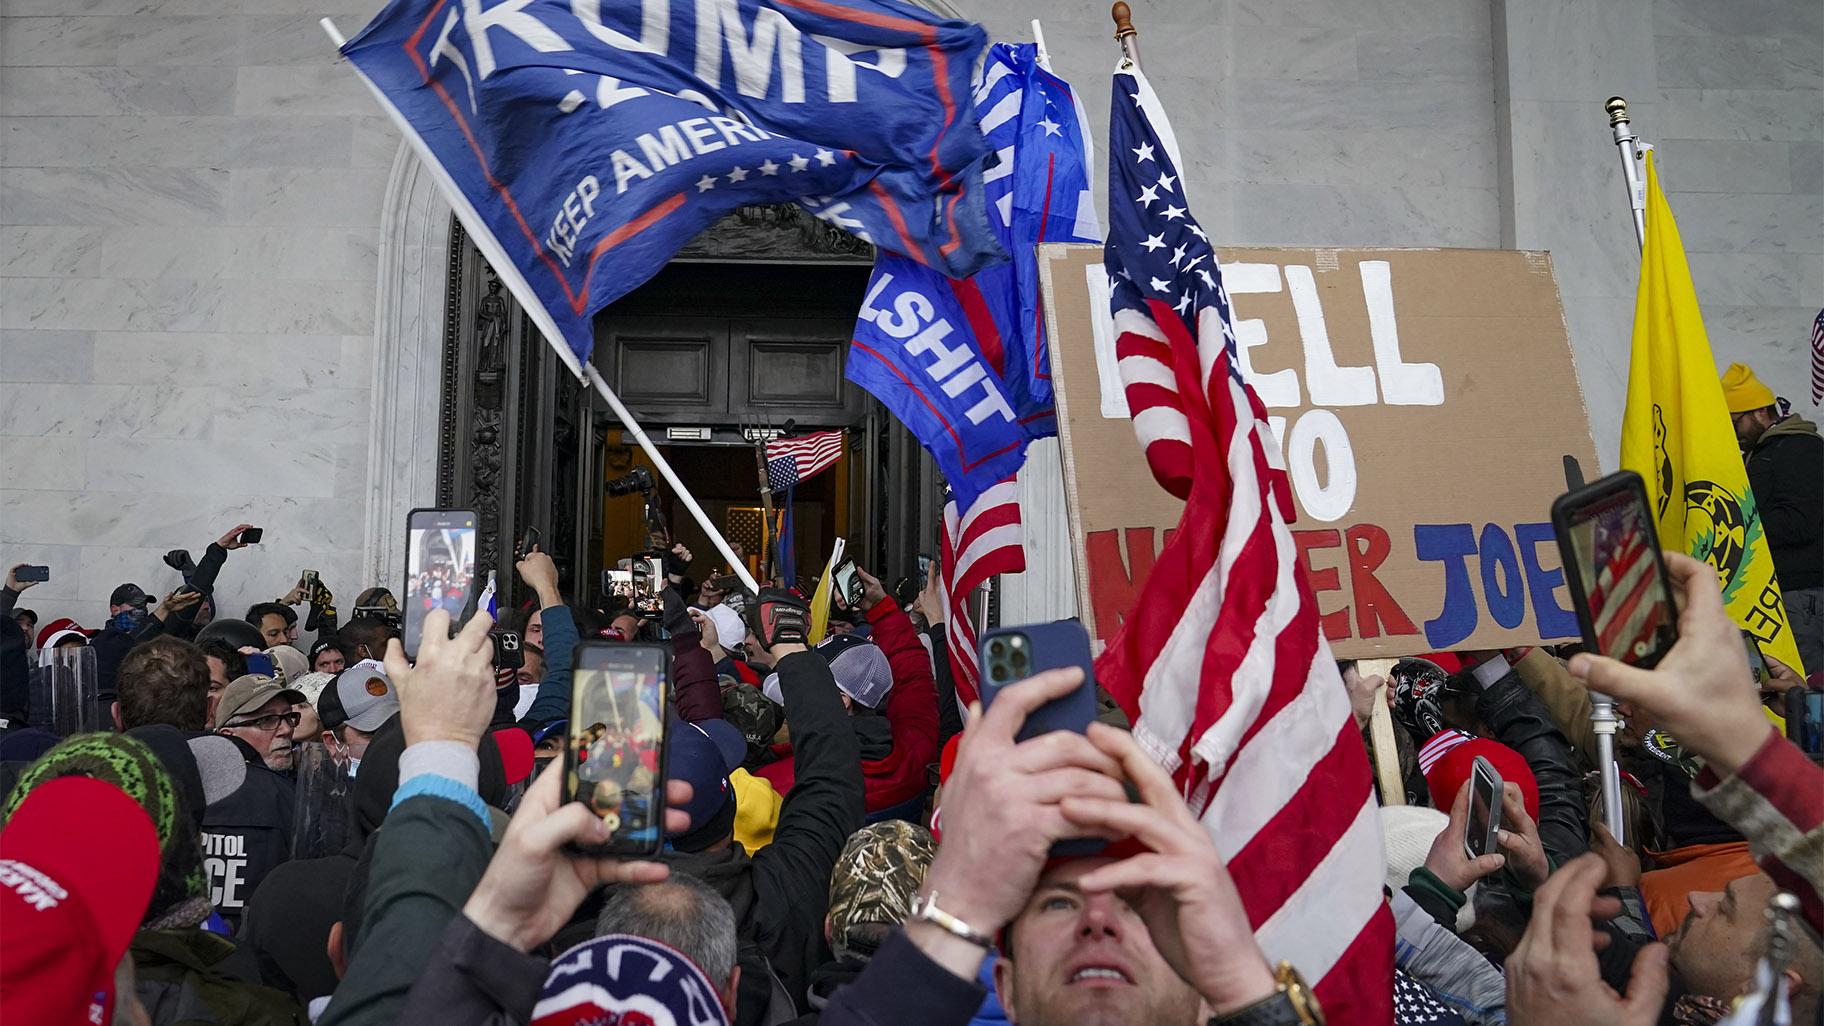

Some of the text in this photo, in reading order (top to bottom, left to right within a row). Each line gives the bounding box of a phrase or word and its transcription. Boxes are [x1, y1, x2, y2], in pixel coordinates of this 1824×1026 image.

[546, 175, 600, 268] KEEP
[1268, 409, 1357, 522] O
[1085, 522, 1583, 650] NER JOE
